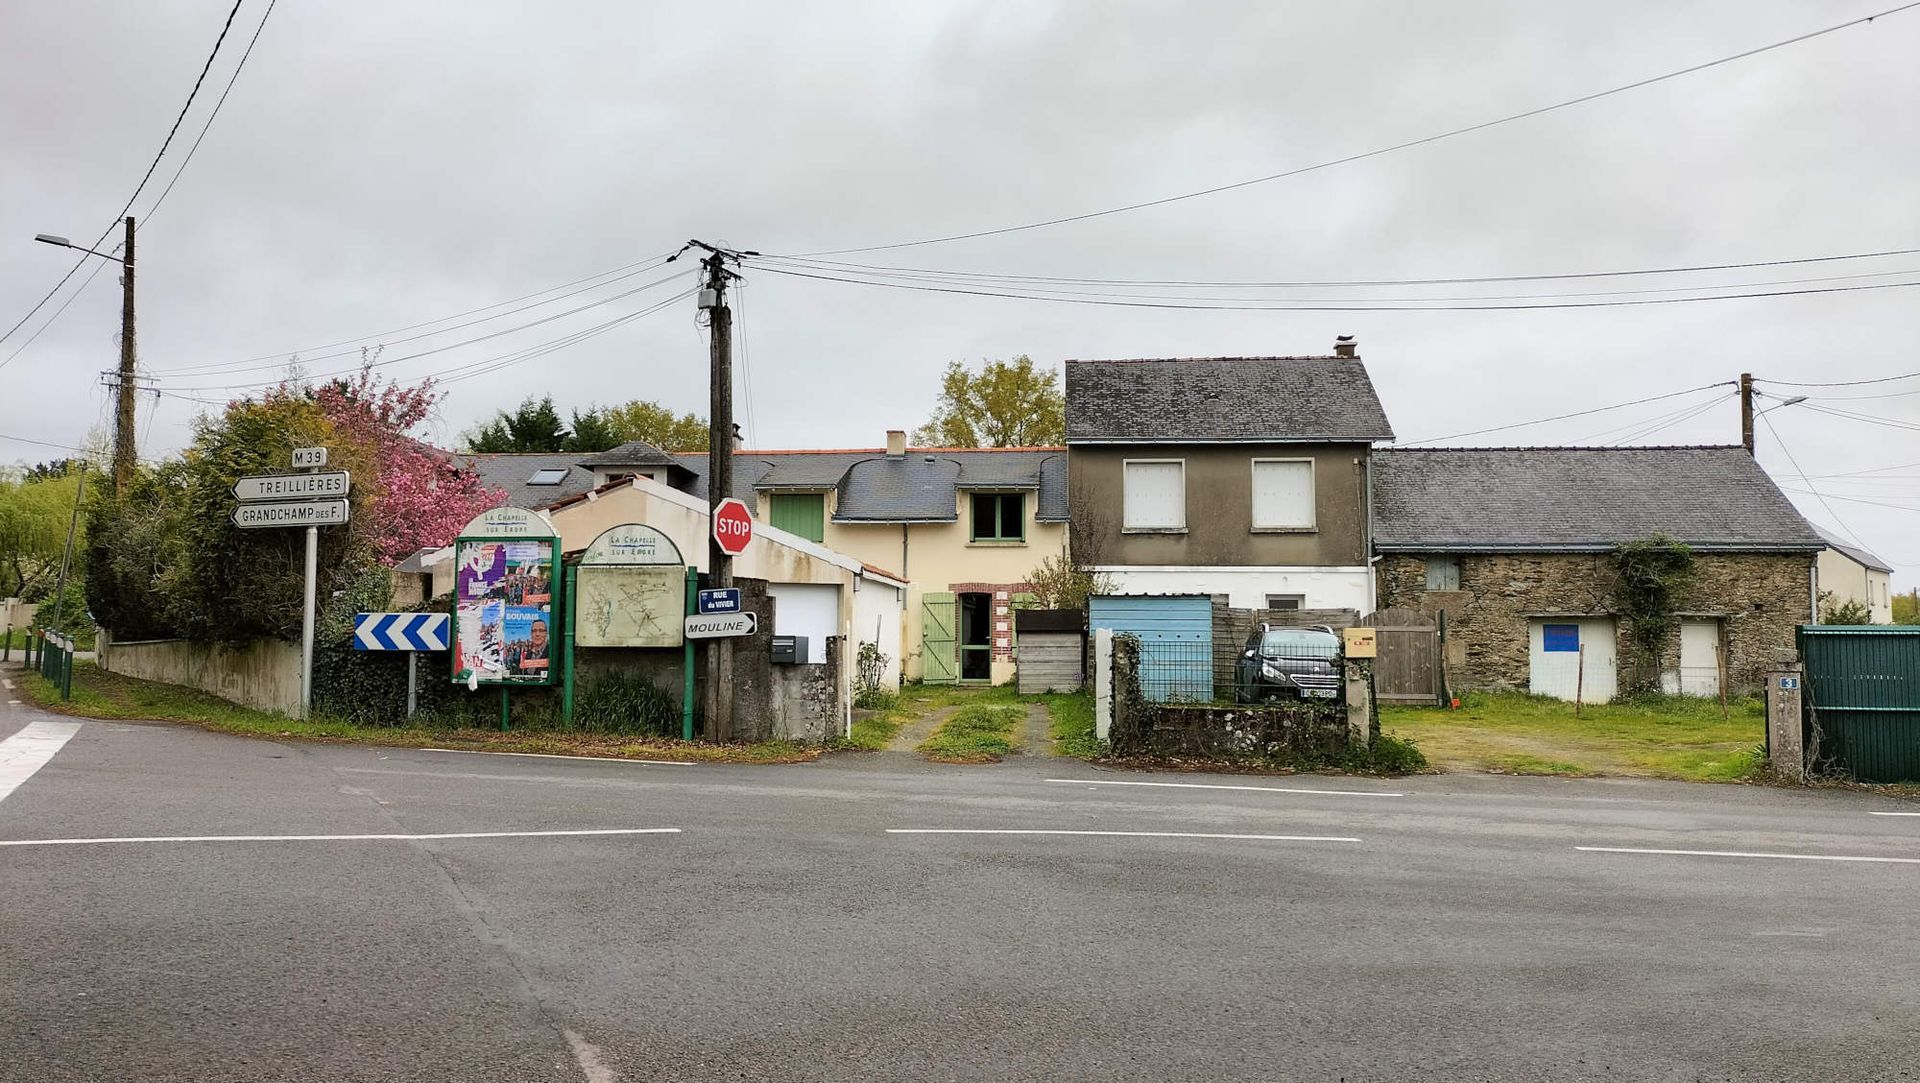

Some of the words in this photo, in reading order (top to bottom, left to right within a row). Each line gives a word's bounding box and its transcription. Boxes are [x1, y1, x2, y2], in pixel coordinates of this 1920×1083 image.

[295, 452, 303, 464] M
[307, 451, 321, 463] 39
[259, 477, 341, 494] TREILLIÈRES
[243, 507, 314, 522] GRANDCHAMP
[316, 510, 329, 519] DES
[331, 506, 340, 518] F.
[719, 518, 750, 537] STOP
[624, 535, 656, 544] CHAPELLE
[713, 591, 728, 599] RUE
[715, 600, 735, 608] VIVIER
[688, 621, 744, 633] MOULINE
[1785, 678, 1793, 687] 3
